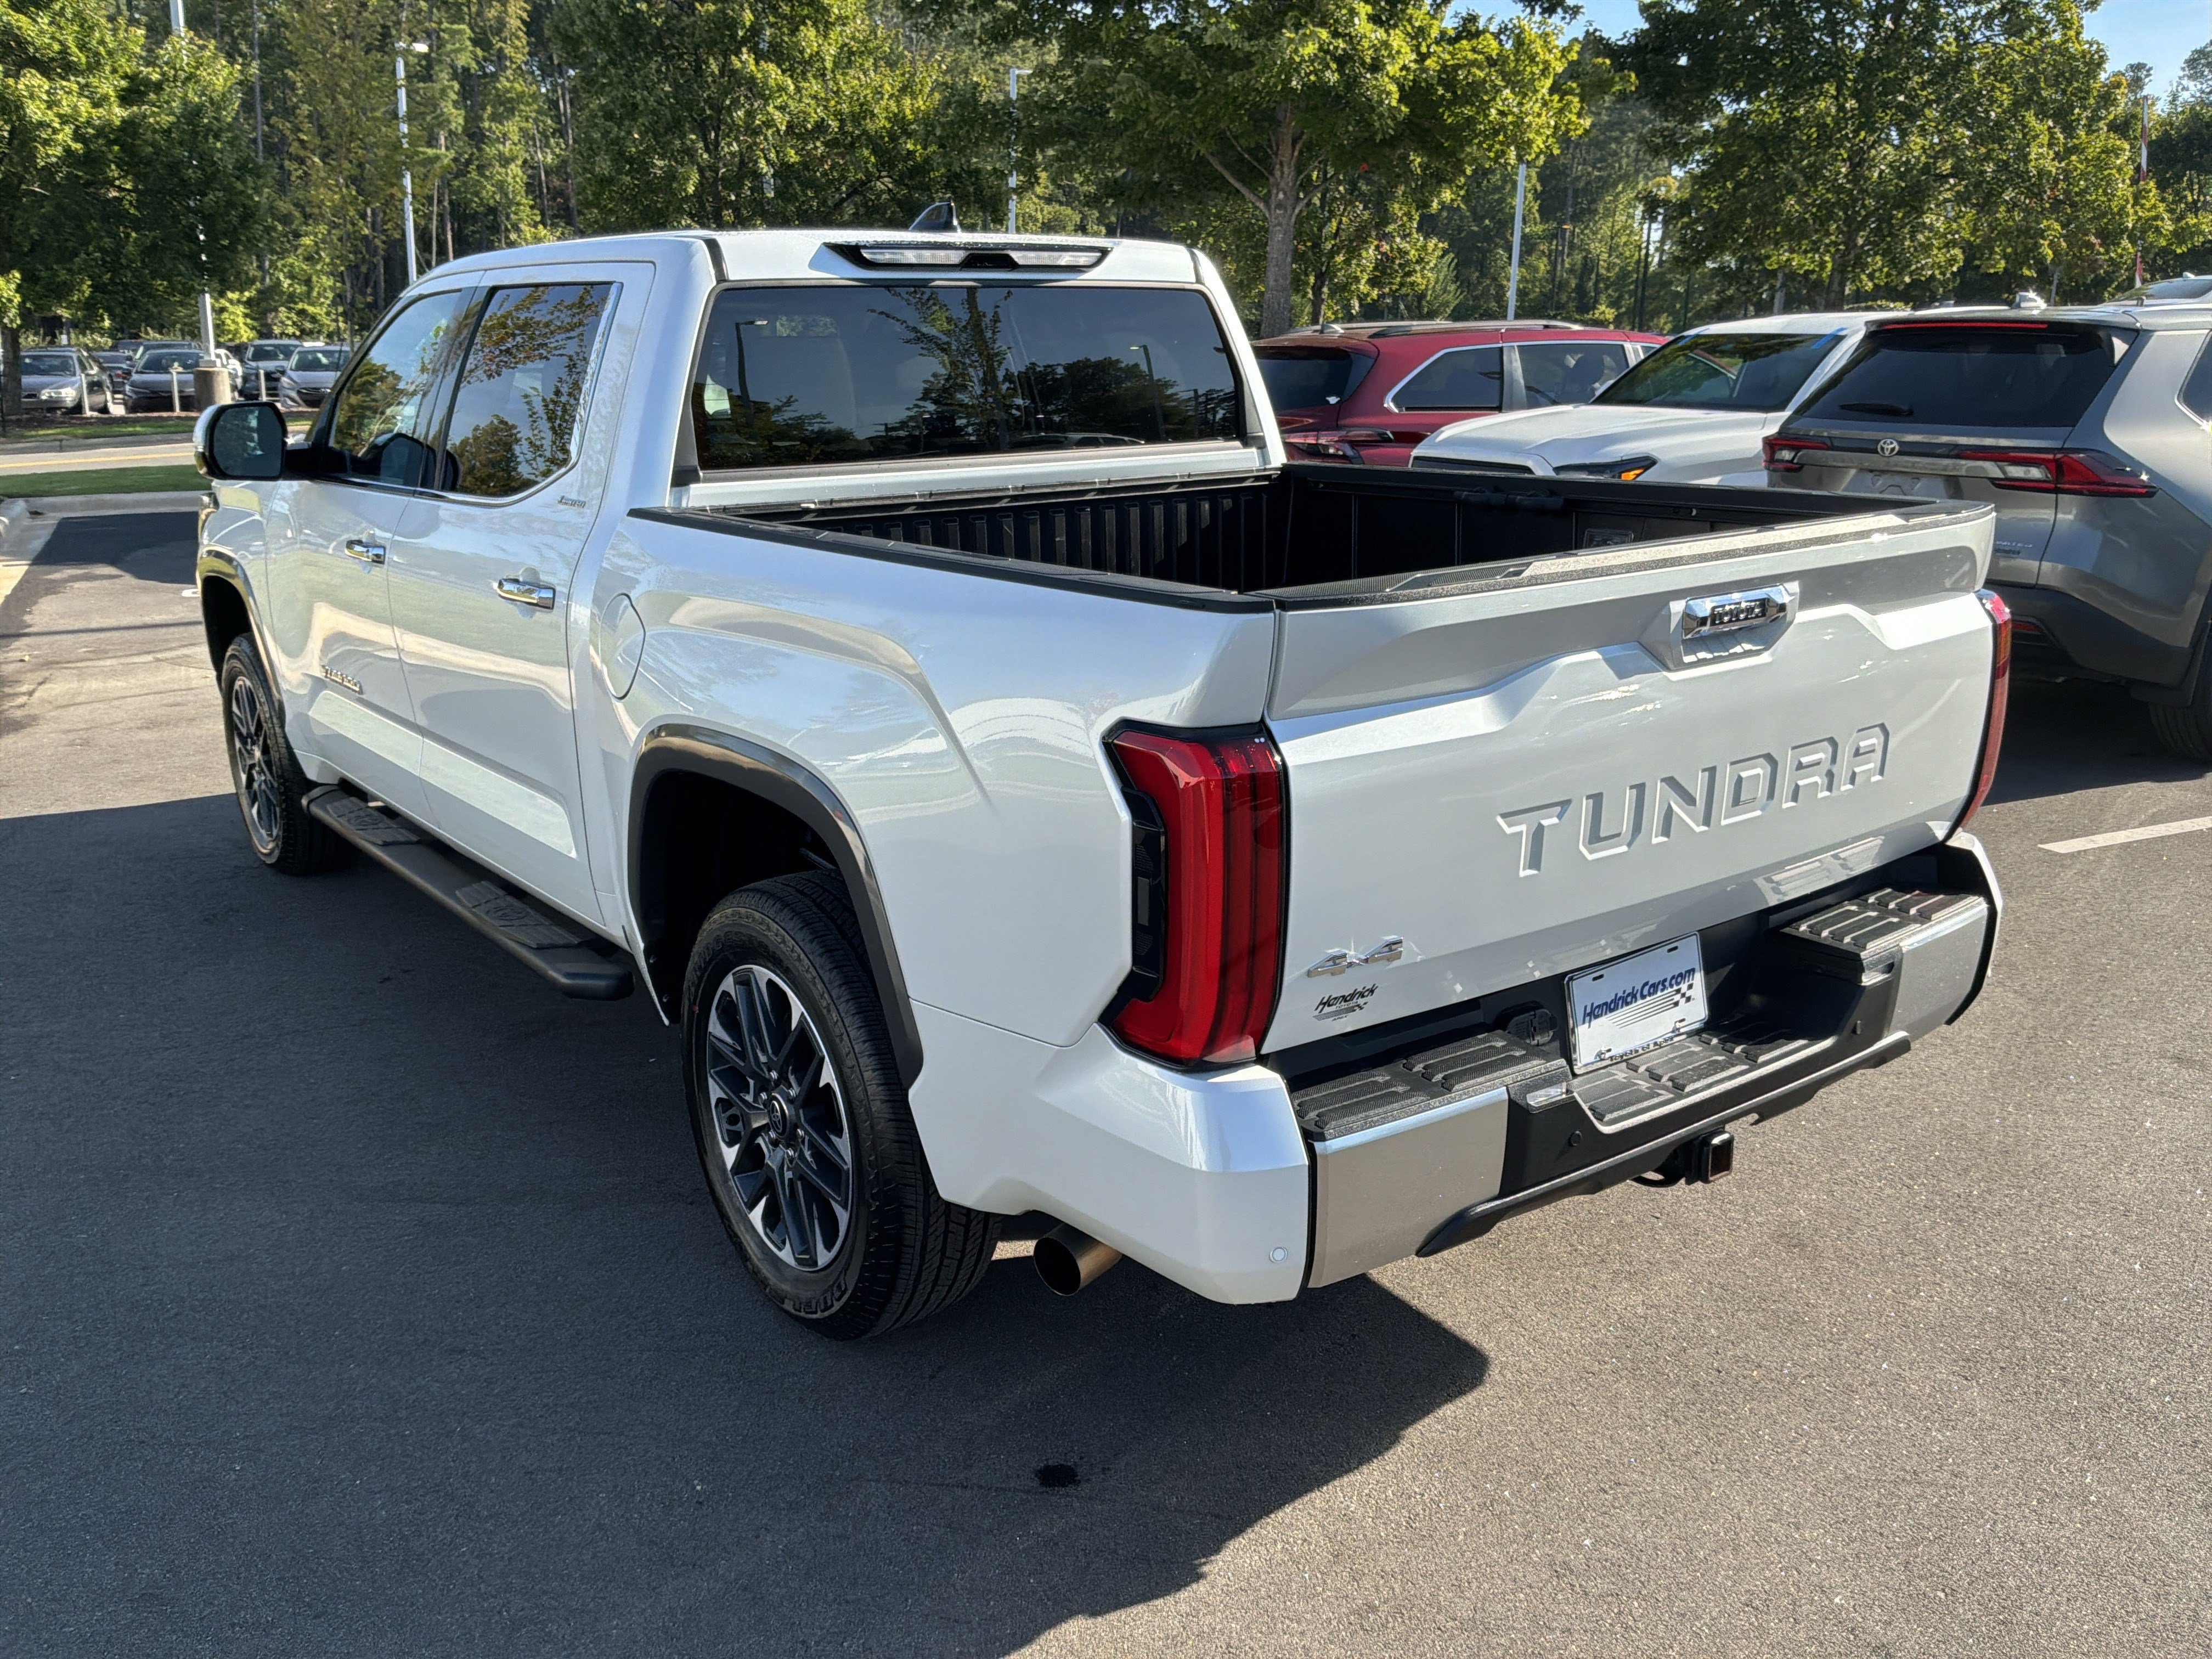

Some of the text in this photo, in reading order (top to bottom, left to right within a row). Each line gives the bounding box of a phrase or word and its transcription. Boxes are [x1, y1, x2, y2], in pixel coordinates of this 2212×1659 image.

[1713, 601, 1762, 624] TOYOTA
[1497, 722, 1889, 877] TUNDRA
[1314, 983, 1379, 1014] Hendrick
[1335, 1000, 1358, 1009] TOYOTA
